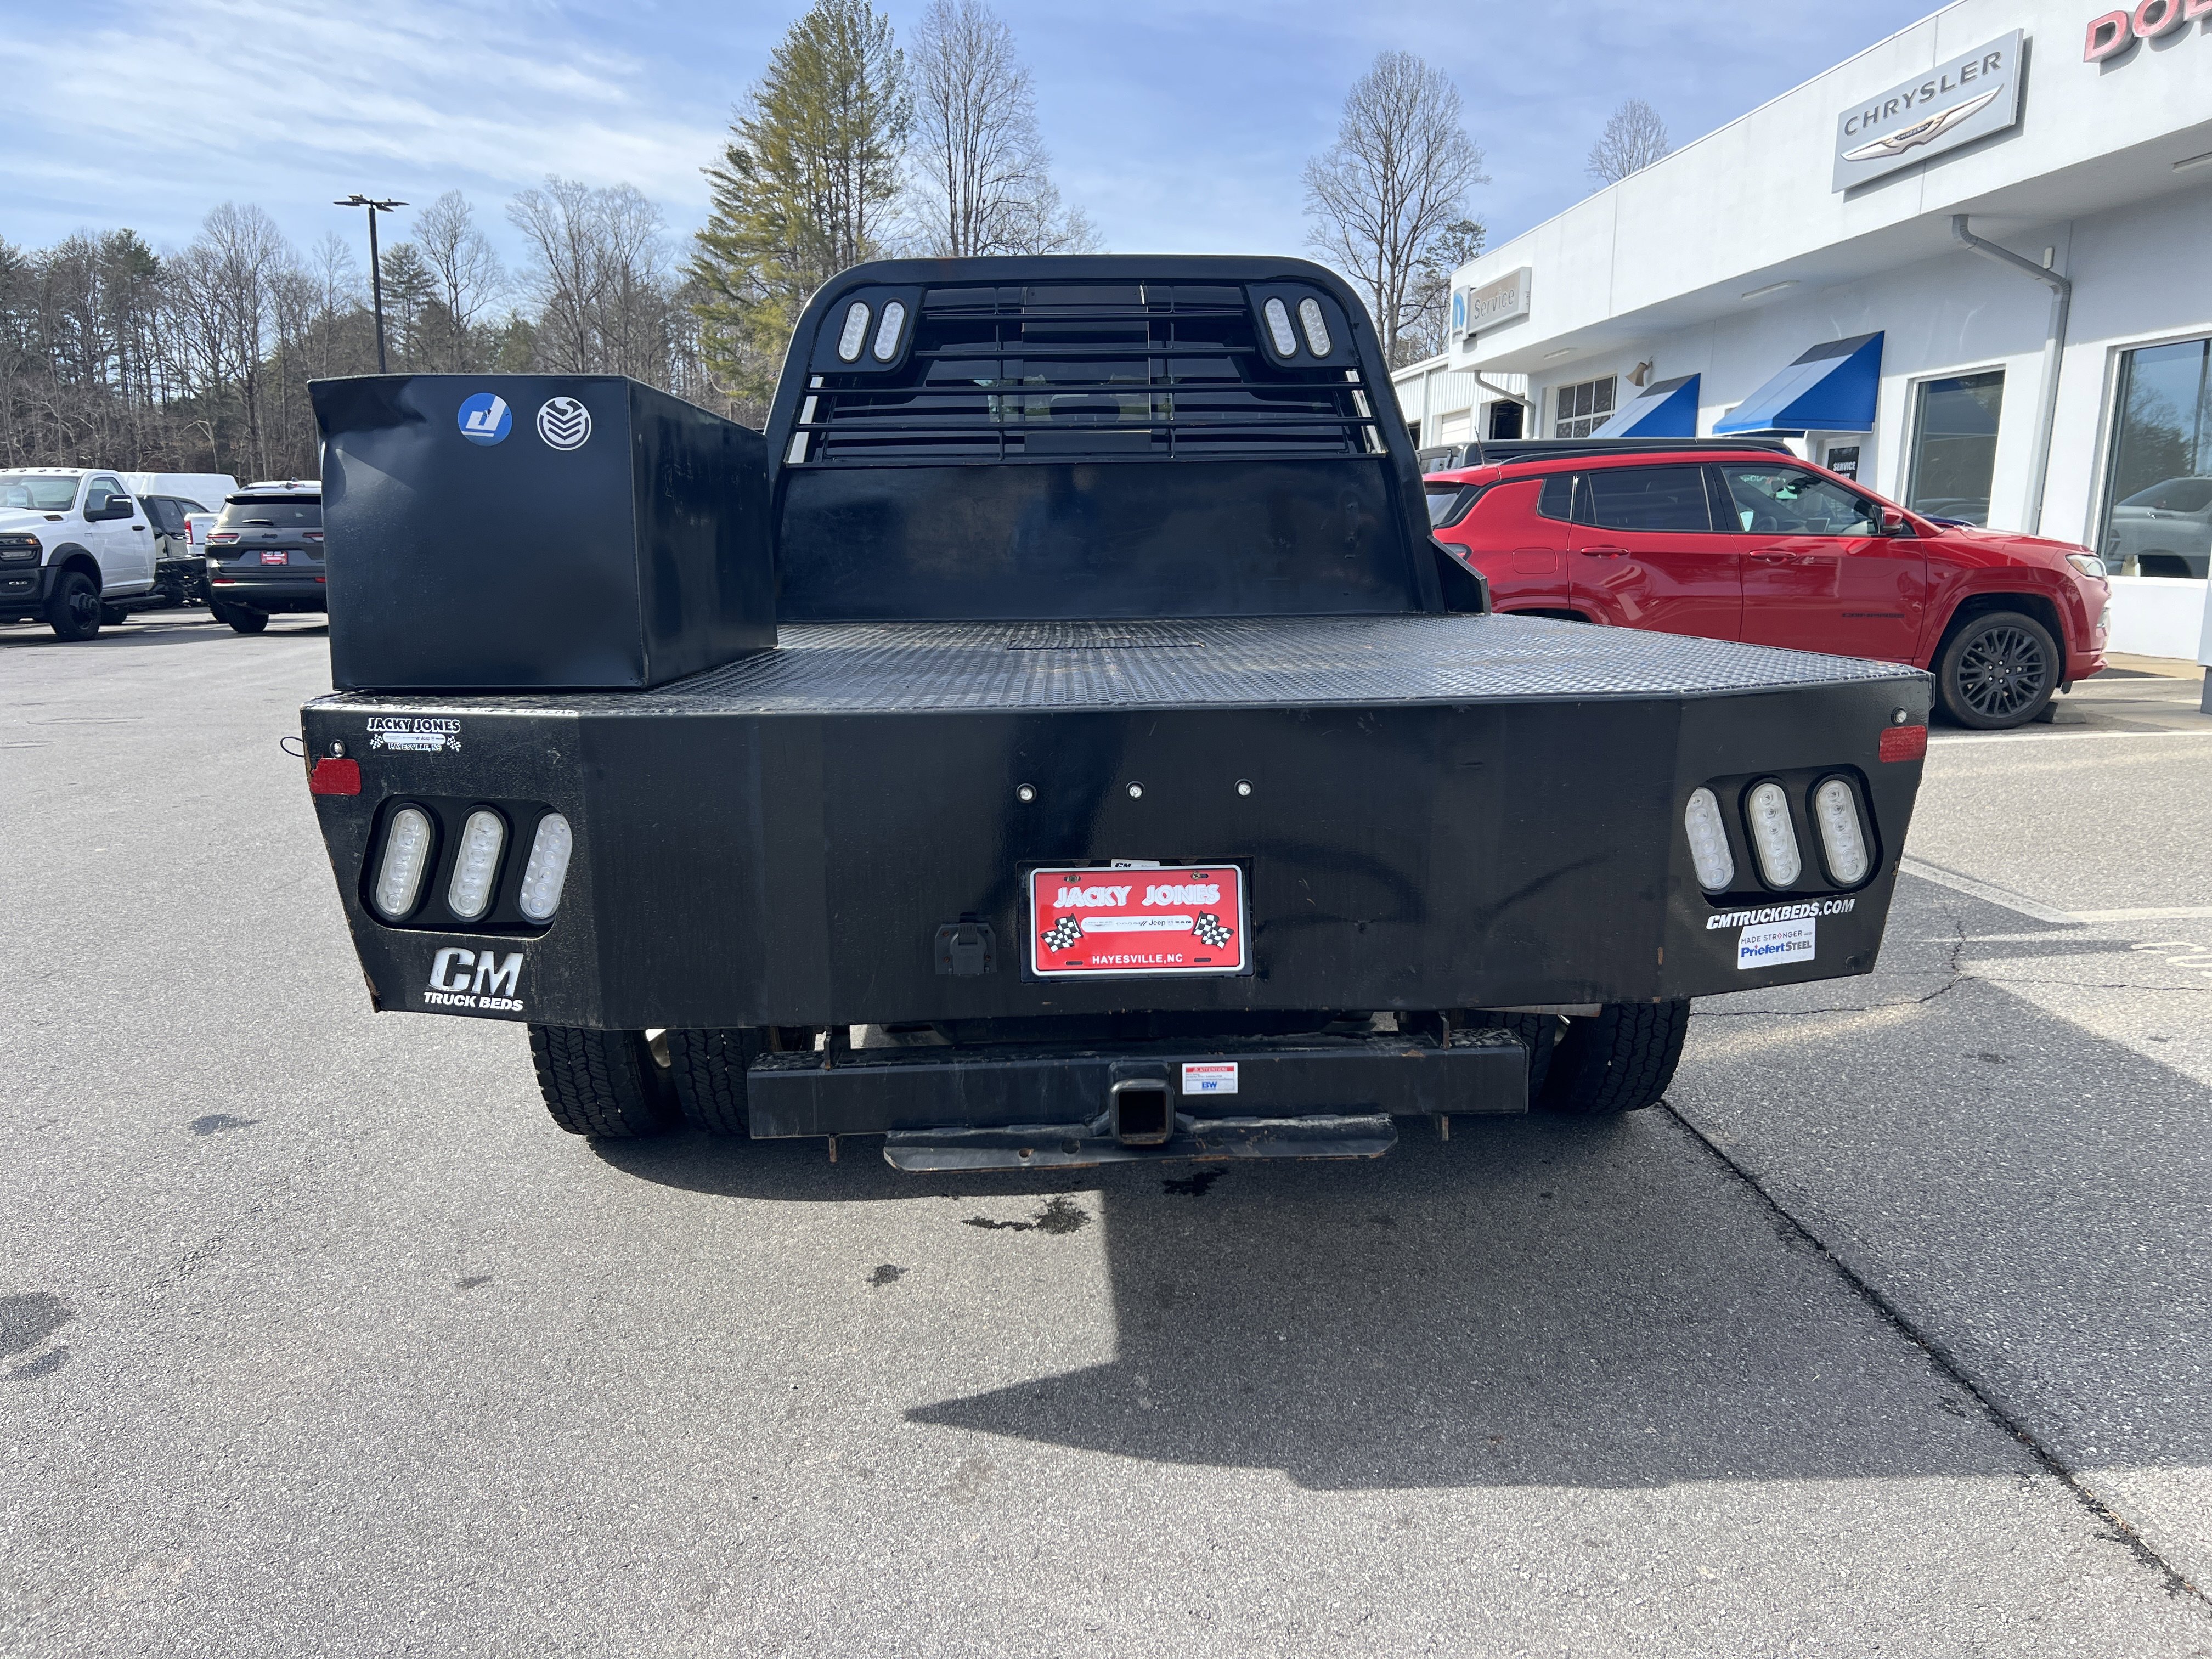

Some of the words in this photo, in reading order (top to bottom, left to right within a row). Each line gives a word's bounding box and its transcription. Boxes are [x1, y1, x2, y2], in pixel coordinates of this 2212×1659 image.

[1844, 51, 2001, 137] CHRYSLER
[1474, 288, 1515, 320] Service
[1833, 461, 1856, 471] SERVICE
[366, 717, 411, 732] JACKY
[413, 718, 461, 733] JONES
[1053, 885, 1132, 908] JACKY
[1141, 884, 1221, 906] JONES
[1706, 898, 1855, 930] CMTRUCKBEDS.COM
[1741, 936, 1762, 945] MADE
[428, 947, 524, 997] CM
[424, 992, 477, 1007] TRUCK
[479, 996, 524, 1011] BEDS
